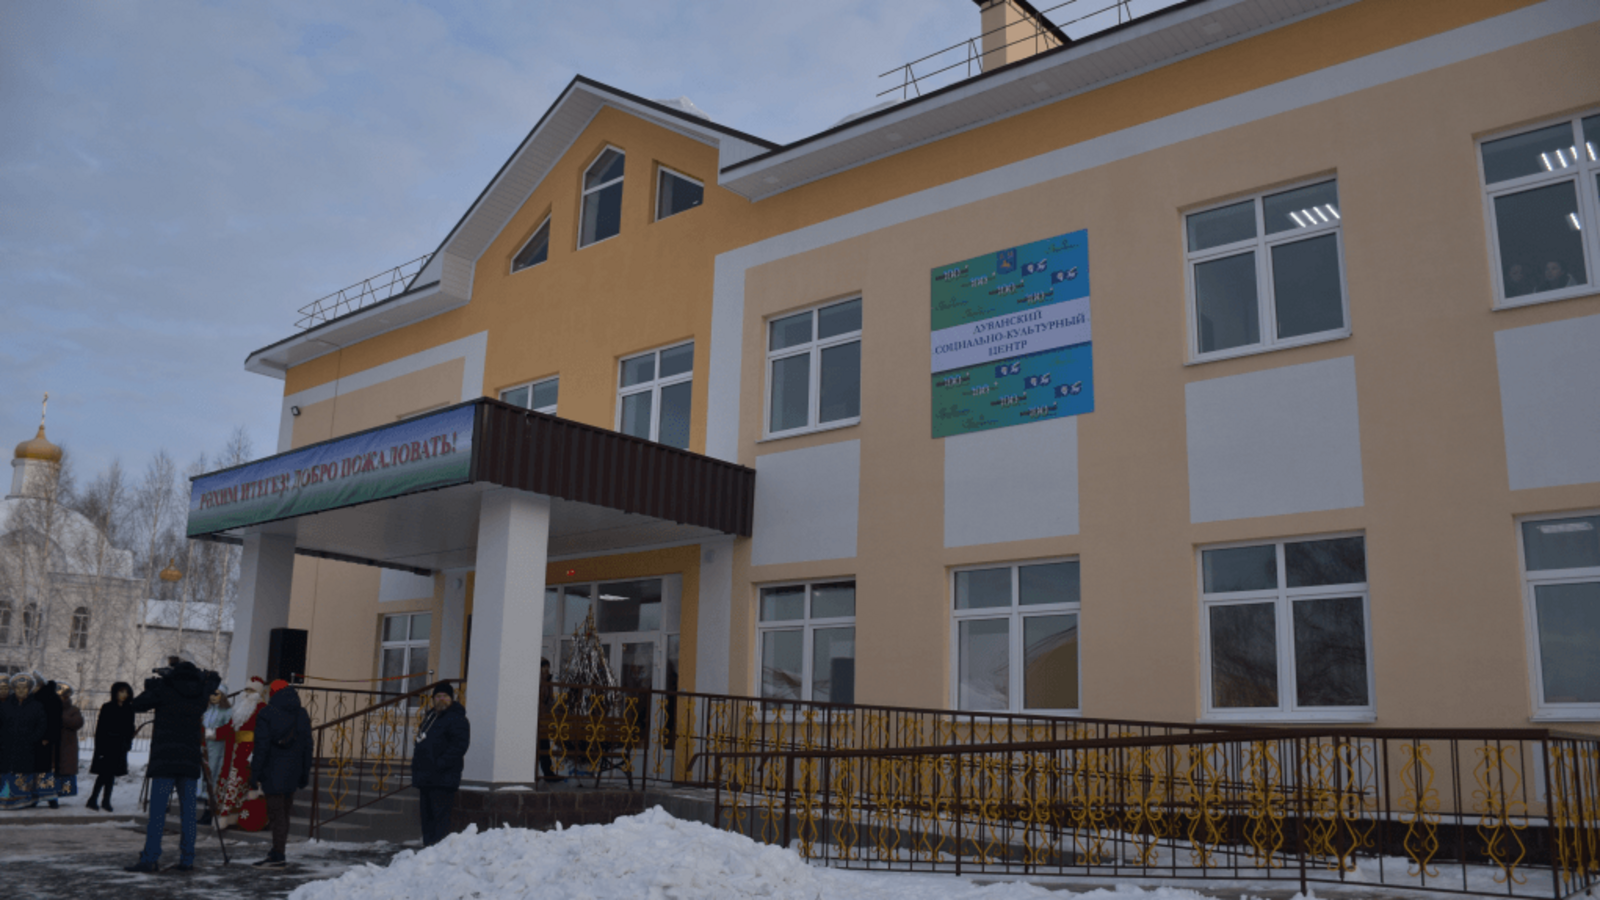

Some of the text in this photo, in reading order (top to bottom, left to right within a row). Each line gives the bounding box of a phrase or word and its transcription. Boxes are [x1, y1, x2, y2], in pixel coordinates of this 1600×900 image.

[934, 313, 1086, 355] СОЦИАЛЬНО-КУЛЬТУРНЫЙ
[973, 310, 1042, 335] ДУВАНСКИЙ
[988, 340, 1028, 357] ЦЕНТР
[292, 461, 339, 491] ДОБРО
[341, 430, 458, 479] ПОЖАЛОВАТЬ!
